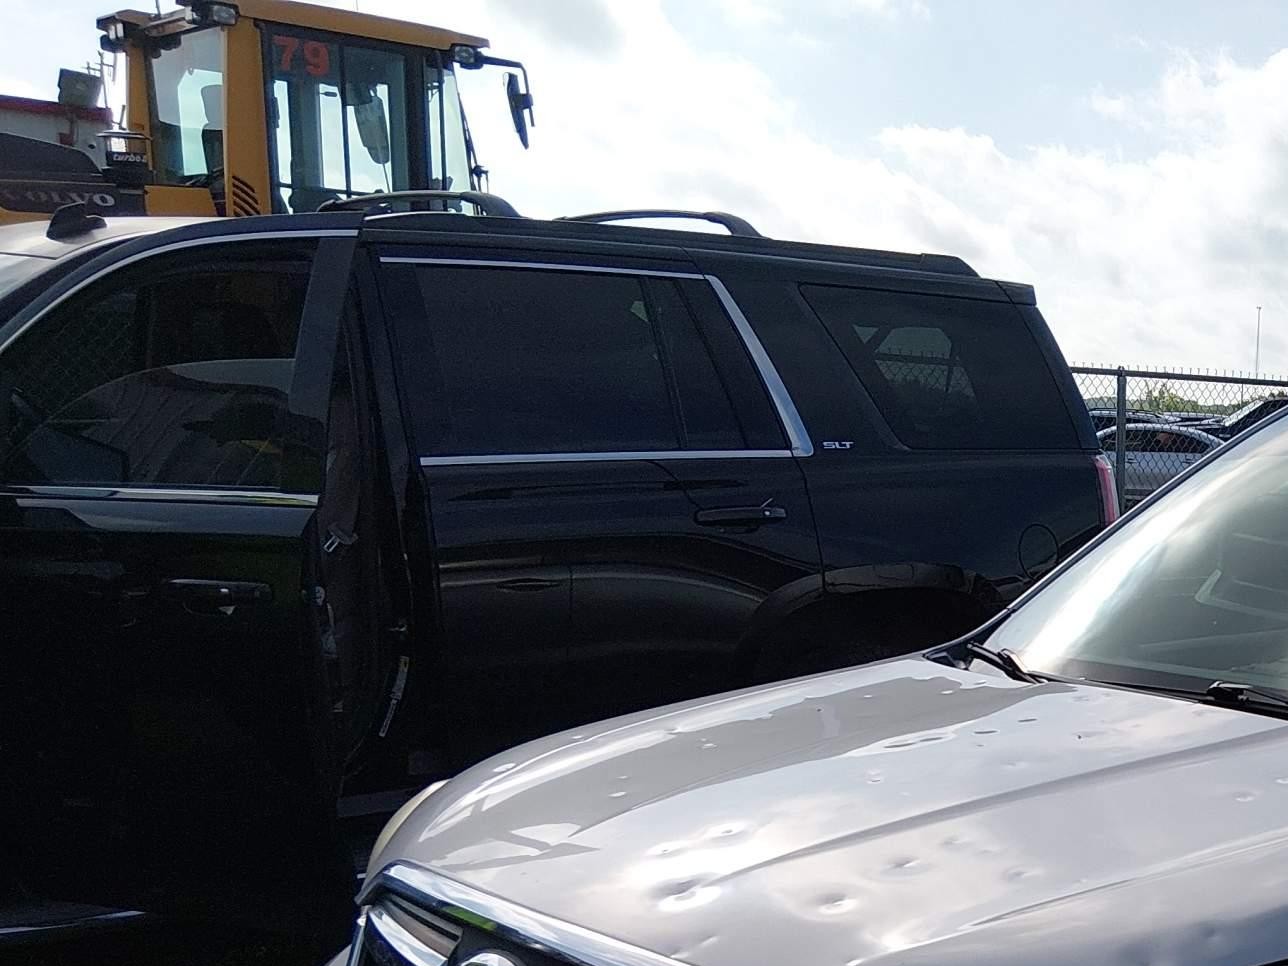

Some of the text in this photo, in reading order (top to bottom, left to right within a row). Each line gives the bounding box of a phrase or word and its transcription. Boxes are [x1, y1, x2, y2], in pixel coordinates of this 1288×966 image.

[271, 35, 330, 76] 79
[113, 153, 141, 162] turbo
[822, 441, 854, 449] SLT
